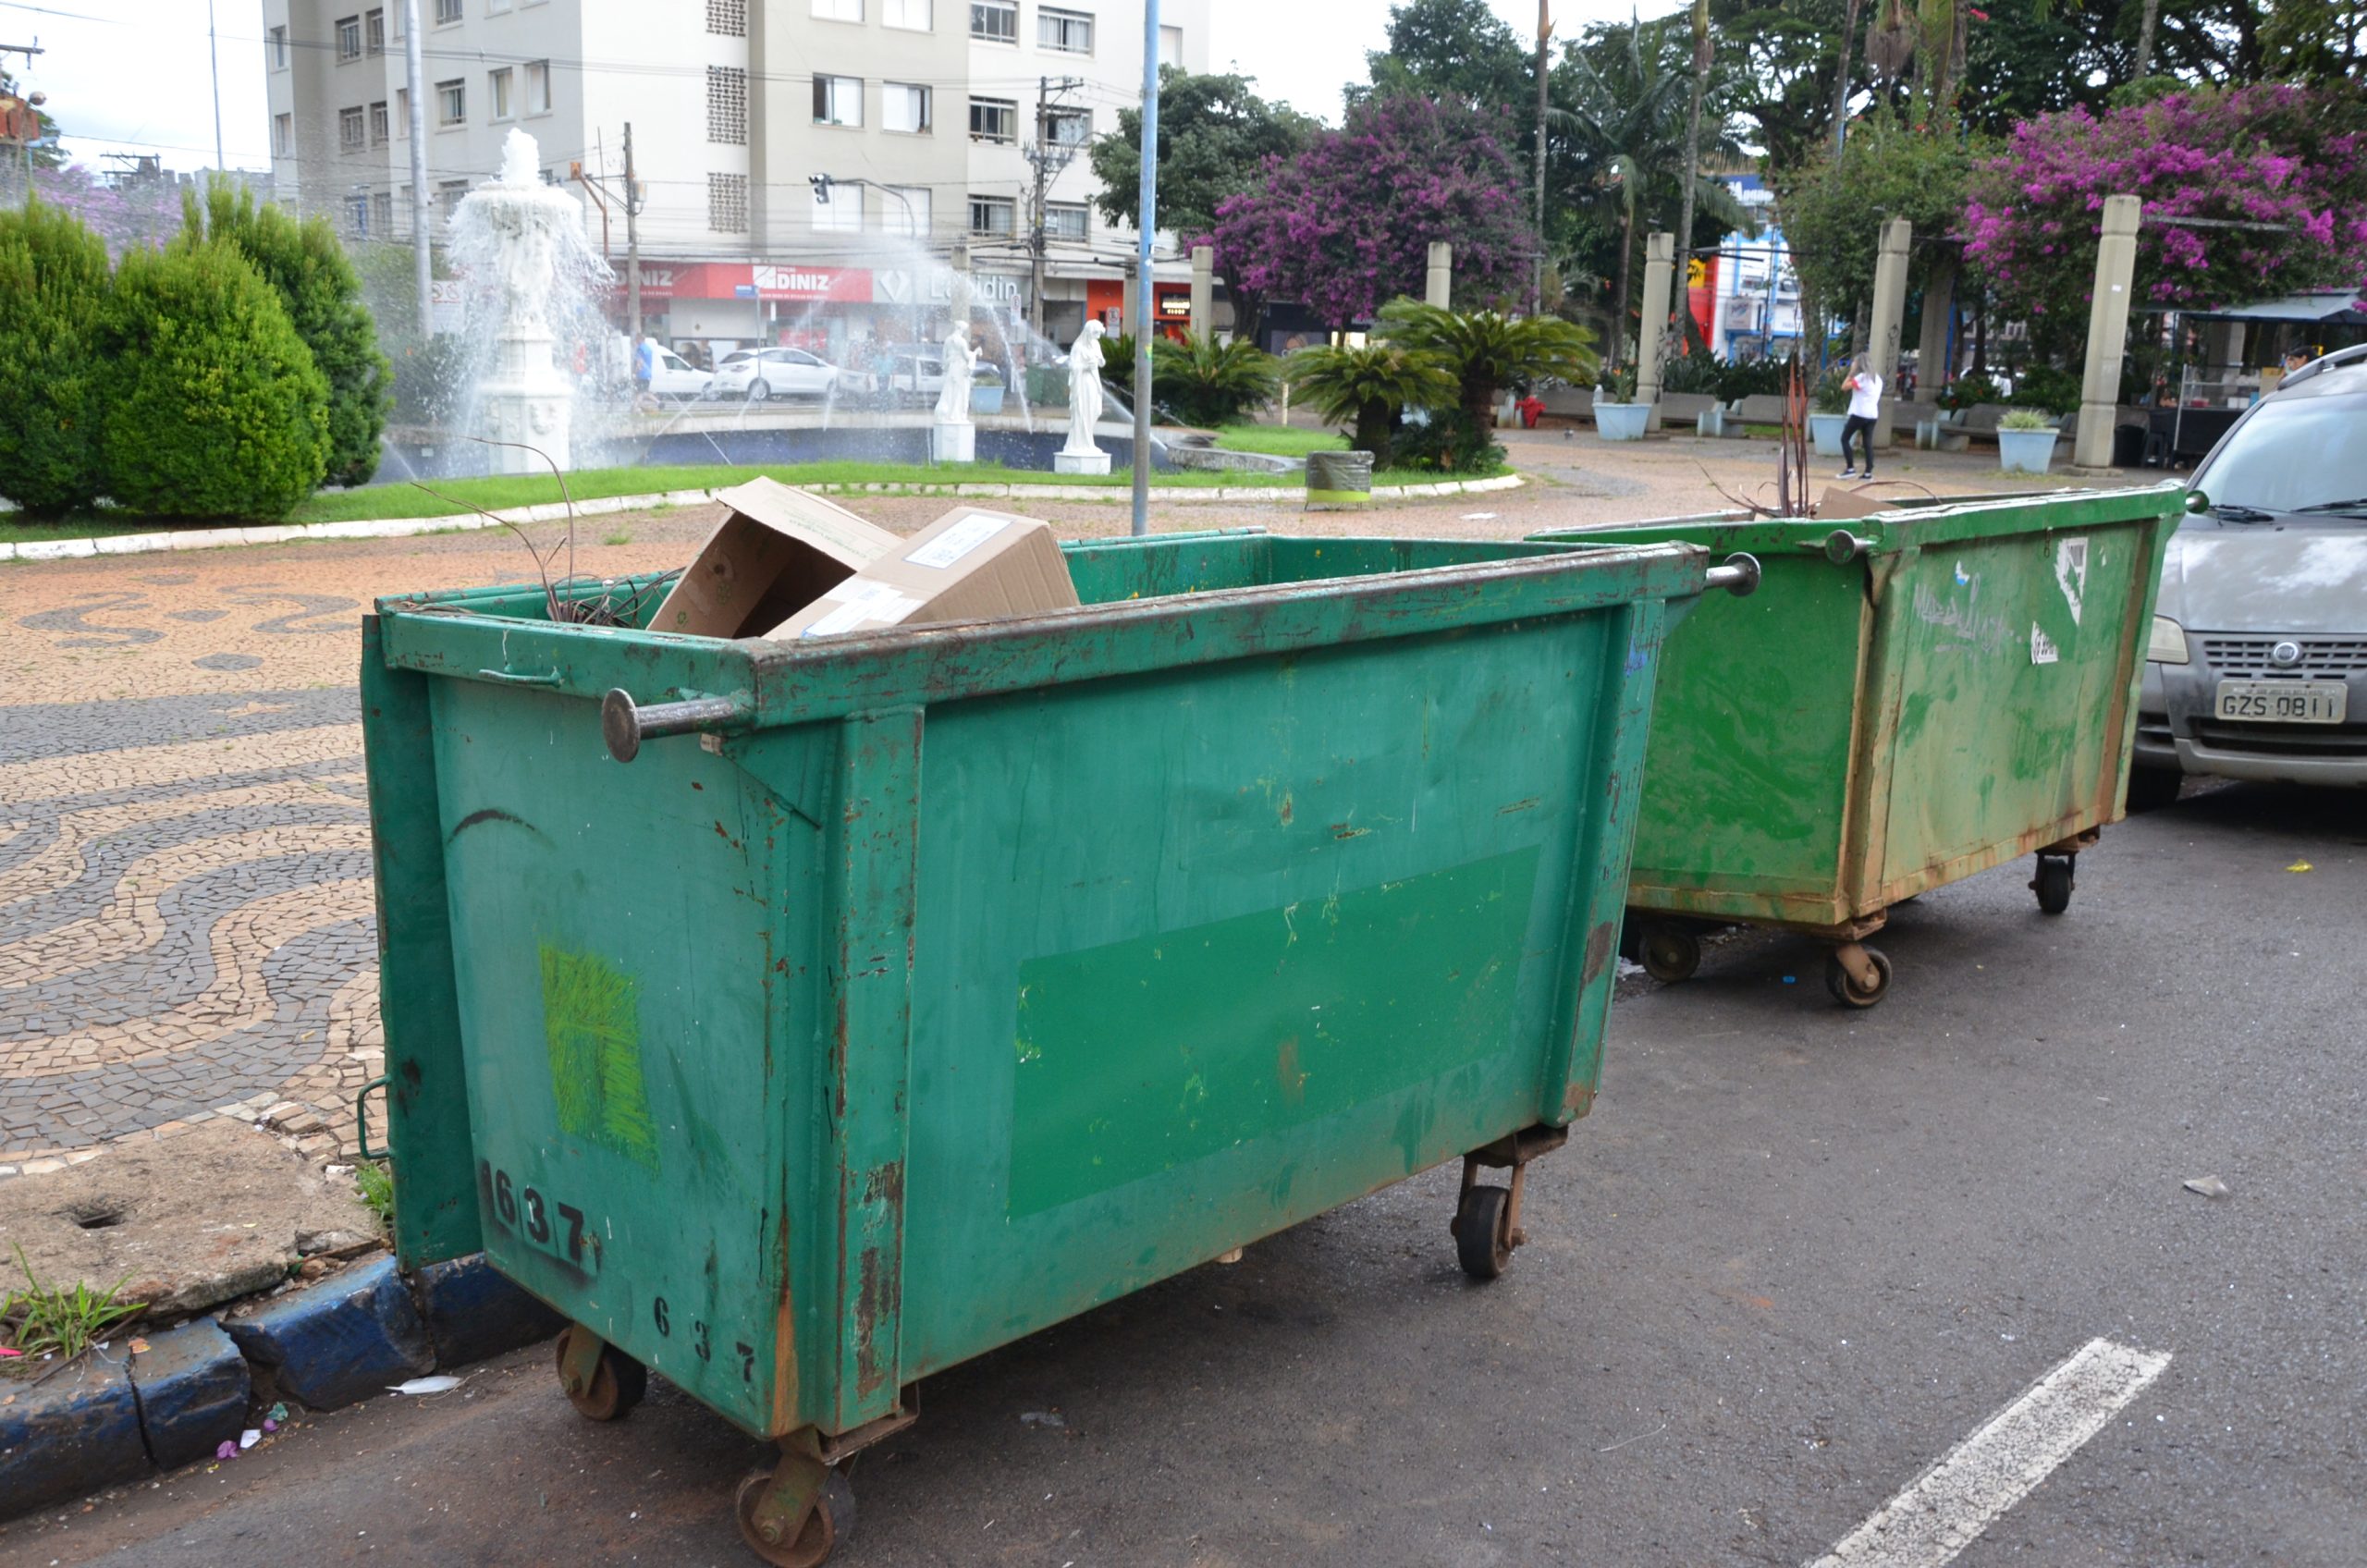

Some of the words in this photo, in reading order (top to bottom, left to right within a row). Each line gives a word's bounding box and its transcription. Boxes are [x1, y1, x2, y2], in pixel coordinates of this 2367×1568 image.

[615, 269, 672, 287] DNIZ
[777, 273, 829, 290] DINIZ
[930, 275, 1017, 300] Lidin
